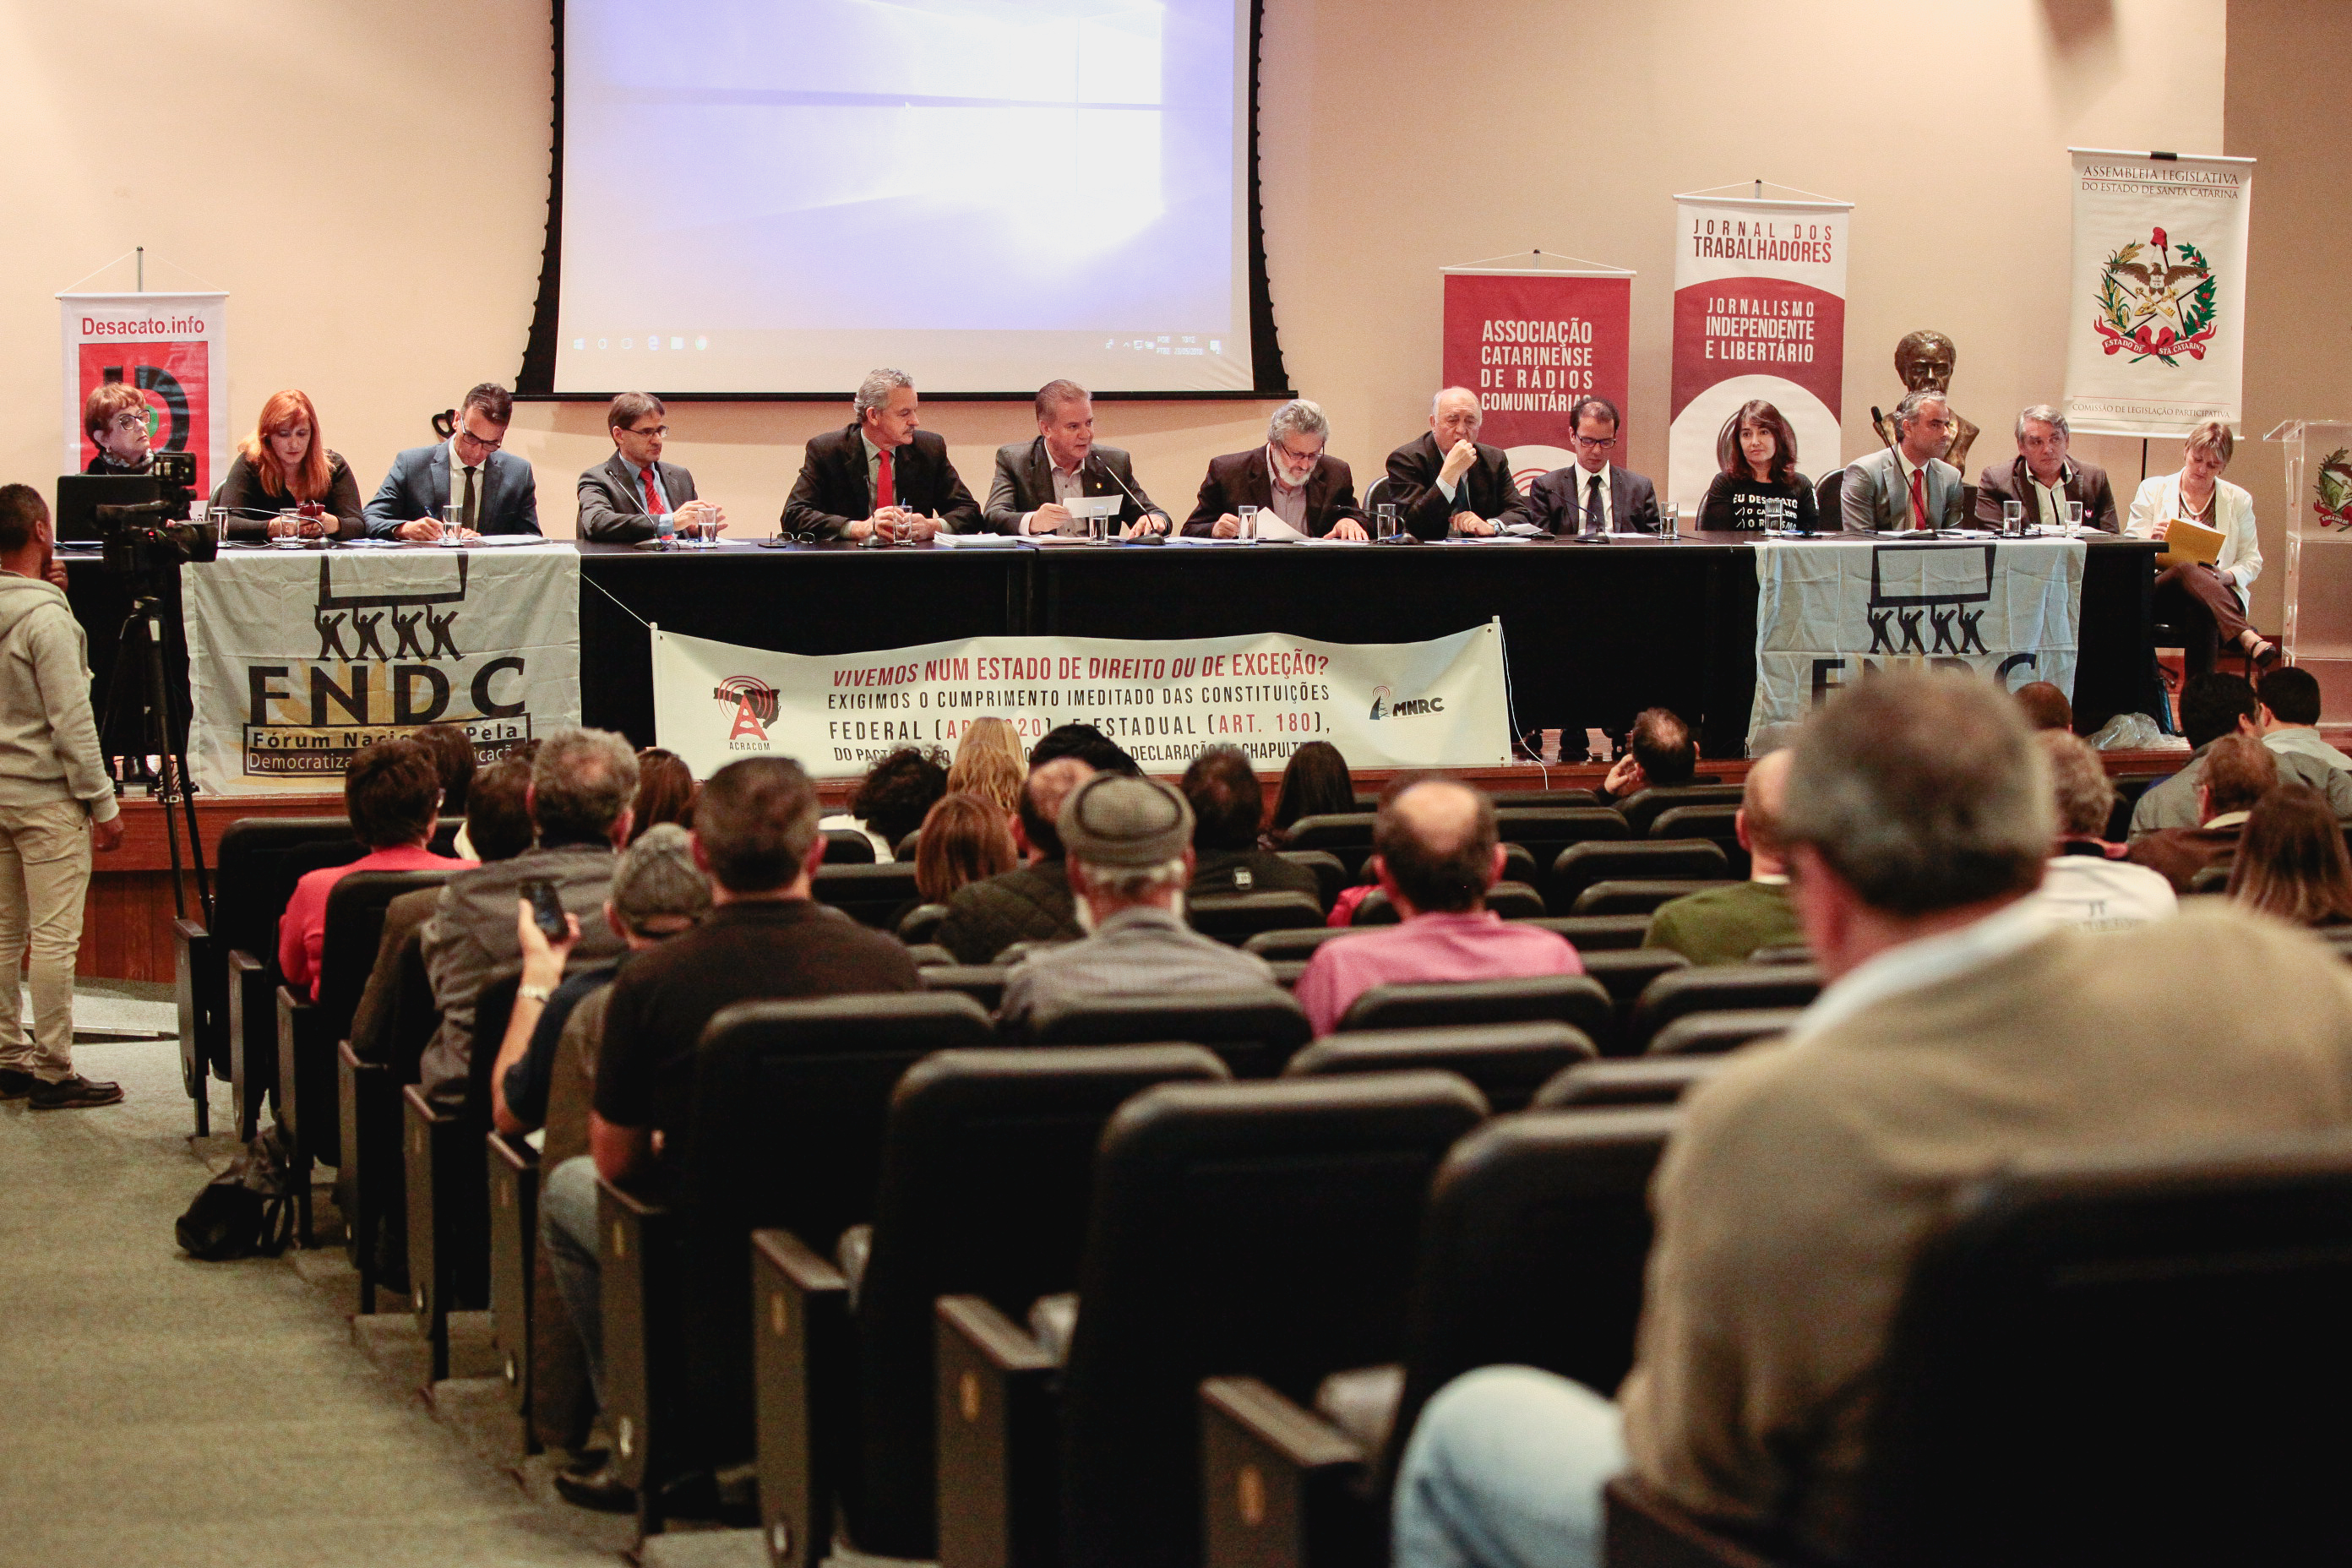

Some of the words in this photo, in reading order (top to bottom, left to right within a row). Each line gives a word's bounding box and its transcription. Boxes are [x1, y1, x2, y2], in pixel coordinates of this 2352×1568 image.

[2082, 166, 2158, 180] ASSEMBLEIA
[2163, 170, 2239, 185] LEGISLATIVA
[2082, 182, 2098, 191] DO
[2101, 183, 2138, 193] ESTADO
[2142, 185, 2154, 194] DE
[2156, 187, 2188, 196] SANTA
[2190, 188, 2239, 199] CATARINA
[1693, 219, 1776, 238] JORNAL
[1794, 224, 1832, 241] DOS
[1693, 236, 1832, 264] TRABALHADORES
[1707, 297, 1814, 318] JORNALISMO
[82, 316, 204, 335] Desacato.info
[1482, 317, 1592, 346] ASSOCIAÇÃO
[1706, 316, 1815, 340] INDEPENDENTE
[1481, 346, 1592, 367] CATARINENSE
[1705, 340, 1714, 359] E
[1721, 339, 1814, 363] LIBERTÁRIO
[2104, 339, 2133, 348] ESTADO
[2133, 344, 2143, 353] DE
[2173, 342, 2204, 353] CATARINA
[1481, 368, 1505, 388] DE
[1517, 365, 1593, 389] RÁDIOS
[1481, 389, 1592, 412] COMUNITÁRIA
[2072, 403, 2114, 412] COMISSÃO
[2127, 406, 2174, 416] LEGISLAÇÃO
[2175, 409, 2230, 418] PARTICIPATIVA
[833, 663, 919, 687] VIVEMOS
[924, 657, 969, 682] NUM
[977, 656, 1051, 680] ESTADO
[1059, 656, 1081, 680] DE
[1089, 657, 1166, 679] DIREITO
[1171, 656, 1196, 678] OU
[1201, 655, 1226, 677] DE
[1233, 648, 1329, 679] EXCEÇÃO?
[248, 656, 525, 725] FNDC
[828, 692, 911, 710] EXIGIMOS
[919, 691, 928, 708] O
[938, 689, 1059, 708] CUMPRIMENTO
[1068, 689, 1154, 706] IMEDITADO
[1162, 687, 1193, 705] DAS
[1201, 681, 1330, 705] CONSTITUIÇÕES
[1392, 697, 1445, 717] MNRC
[253, 732, 331, 749] Fórum
[466, 722, 518, 741] Pela
[830, 720, 923, 740] FEDERAL
[729, 742, 770, 751] ACRACOM
[834, 747, 852, 761] DO
